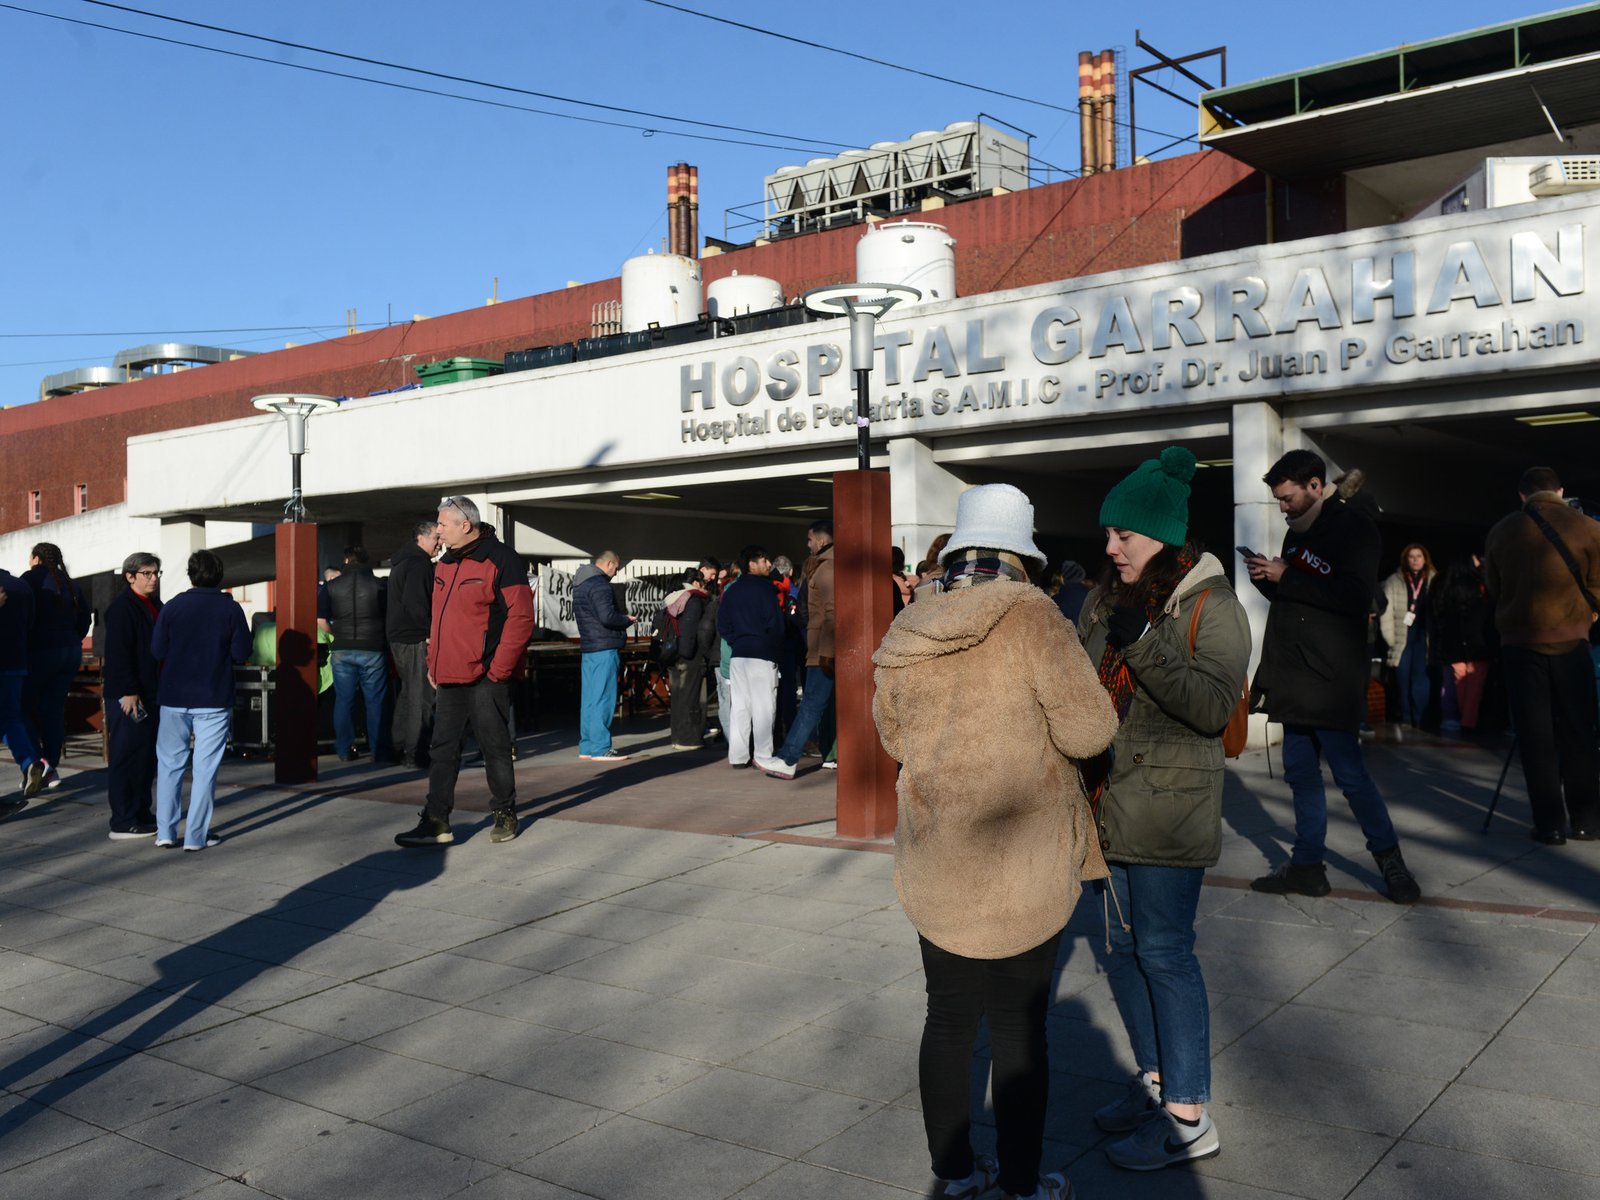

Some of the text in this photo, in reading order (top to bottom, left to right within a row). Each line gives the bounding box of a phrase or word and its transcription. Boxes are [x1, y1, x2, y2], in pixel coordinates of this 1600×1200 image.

[681, 223, 1584, 413] HOSPTAL GARRAHAN
[681, 408, 771, 445] Hospital
[777, 406, 807, 432] de
[813, 391, 924, 429] Pedatria
[1095, 361, 1172, 399] Prof.
[1182, 357, 1229, 389] Dr.
[1238, 350, 1328, 383] Juan
[1341, 337, 1373, 371] P.
[1385, 317, 1584, 365] Garrahan
[549, 569, 564, 596] LA
[1301, 549, 1331, 575] C5N
